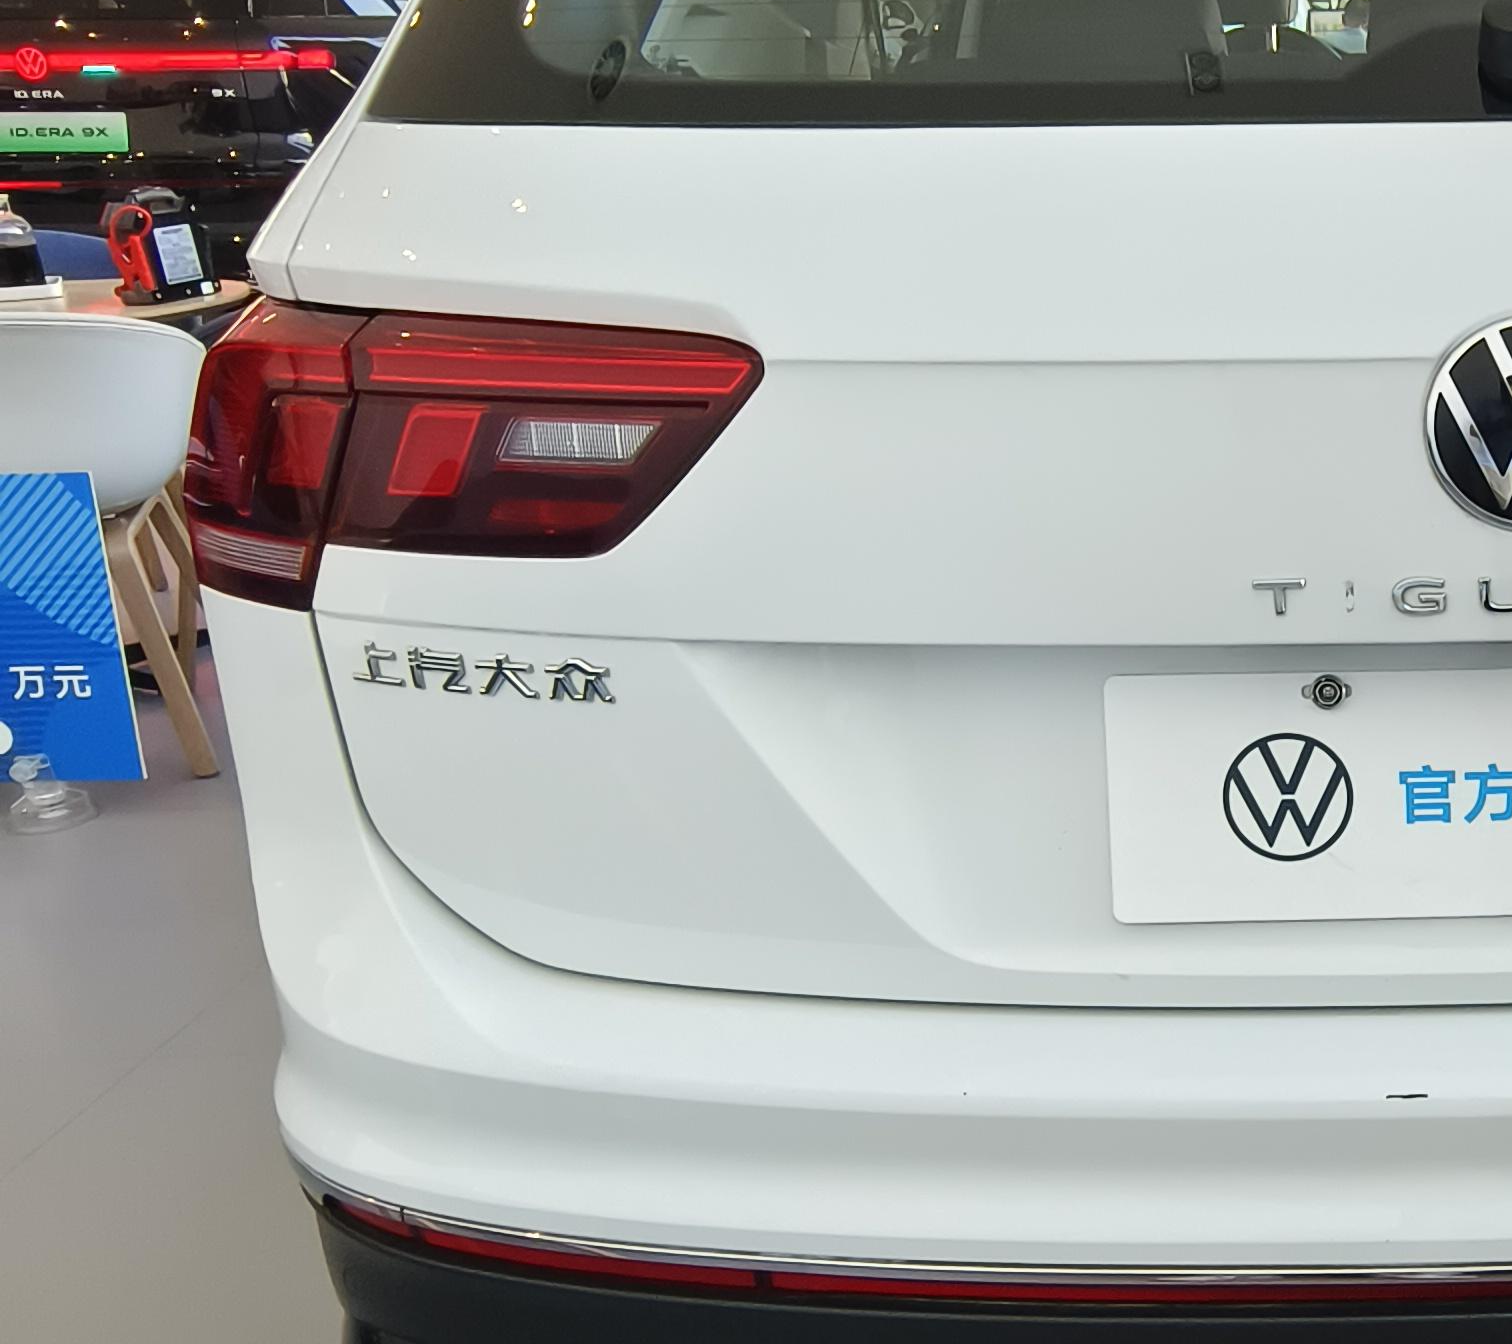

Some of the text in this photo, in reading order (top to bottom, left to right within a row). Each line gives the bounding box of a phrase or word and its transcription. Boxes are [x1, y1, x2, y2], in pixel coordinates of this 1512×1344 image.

[9, 127, 109, 137] ID.ERA 9X
[8, 664, 92, 700] 万元
[352, 640, 616, 704] 上汽大众
